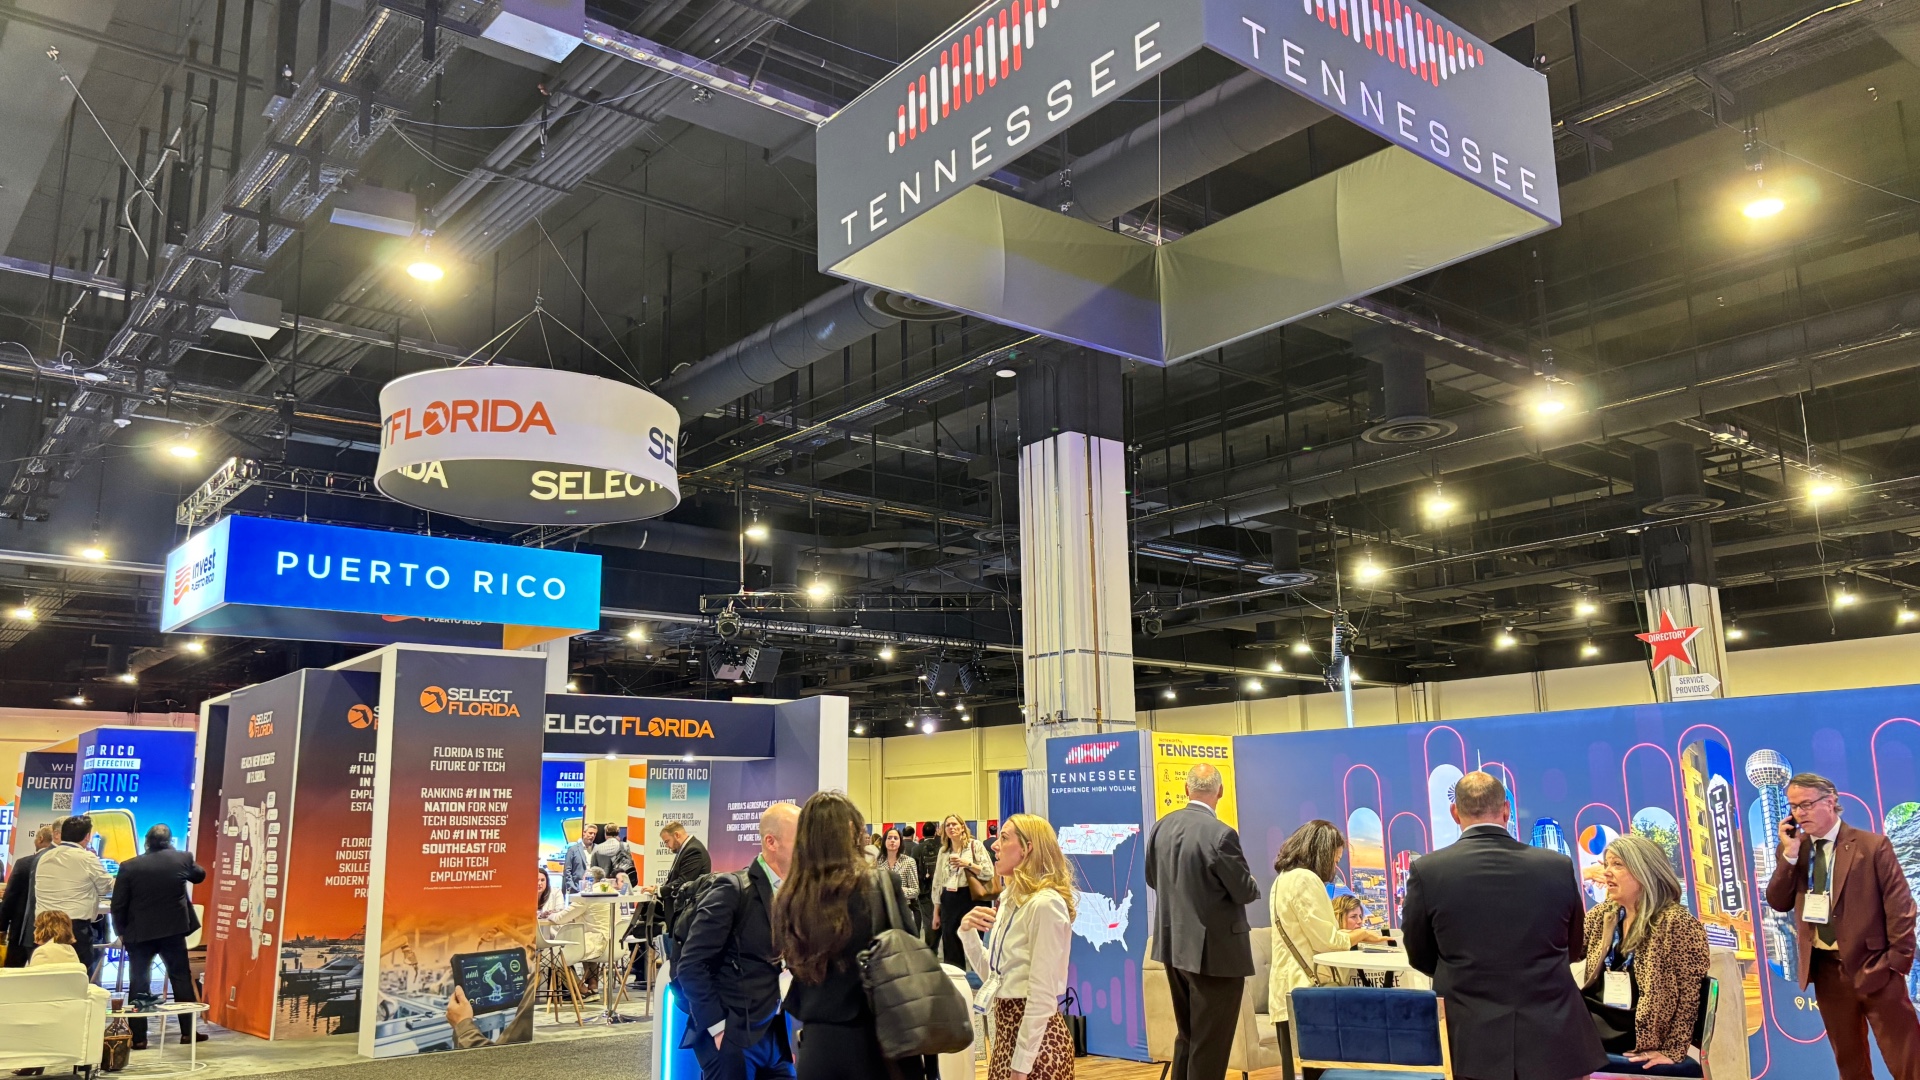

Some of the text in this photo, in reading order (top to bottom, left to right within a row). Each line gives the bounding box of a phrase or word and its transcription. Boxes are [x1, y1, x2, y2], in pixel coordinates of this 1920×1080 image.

[1242, 17, 1540, 205] TENNESSEE
[841, 22, 1162, 246] TENNESSEE
[277, 551, 566, 600] PUERTO RICO
[1648, 629, 1687, 643] DIRECTORY
[1679, 675, 1704, 685] SERVICE
[447, 687, 513, 703] SELECT
[1675, 684, 1710, 694] PROVIDERS
[448, 701, 521, 718] FLORIDA
[544, 713, 715, 739] ELECTFLORIDA
[100, 744, 135, 756] RICO
[433, 746, 504, 759] FLORIDA IS THE
[1158, 743, 1229, 759] TENNESSEE
[97, 759, 135, 767] EFFECTIVE
[358, 752, 376, 763] FLO
[349, 765, 373, 775] #1 IN
[430, 760, 506, 772] FUTURE OF TECH
[559, 772, 584, 780] PUERTO
[650, 767, 708, 780] PUERTO RICO
[1051, 769, 1136, 783] TENNESSEE
[27, 776, 72, 790] PUERTO
[359, 777, 371, 787] IN
[421, 787, 513, 799] RANKING #1 IN THE
[1051, 785, 1137, 794] EXPERIENCE HIGH VOLUME
[424, 801, 508, 812] NATION FOR NEW
[422, 815, 447, 826] TECH
[662, 812, 694, 820] PUERTO RICO
[430, 829, 500, 840] AND #1 IN THE
[422, 842, 507, 854] SOUTHEAST FOR
[1712, 788, 1737, 907] TENNESSEE
[336, 850, 371, 861] INDUST
[439, 856, 489, 868] HIGH TECH
[325, 876, 365, 886] MODERN
